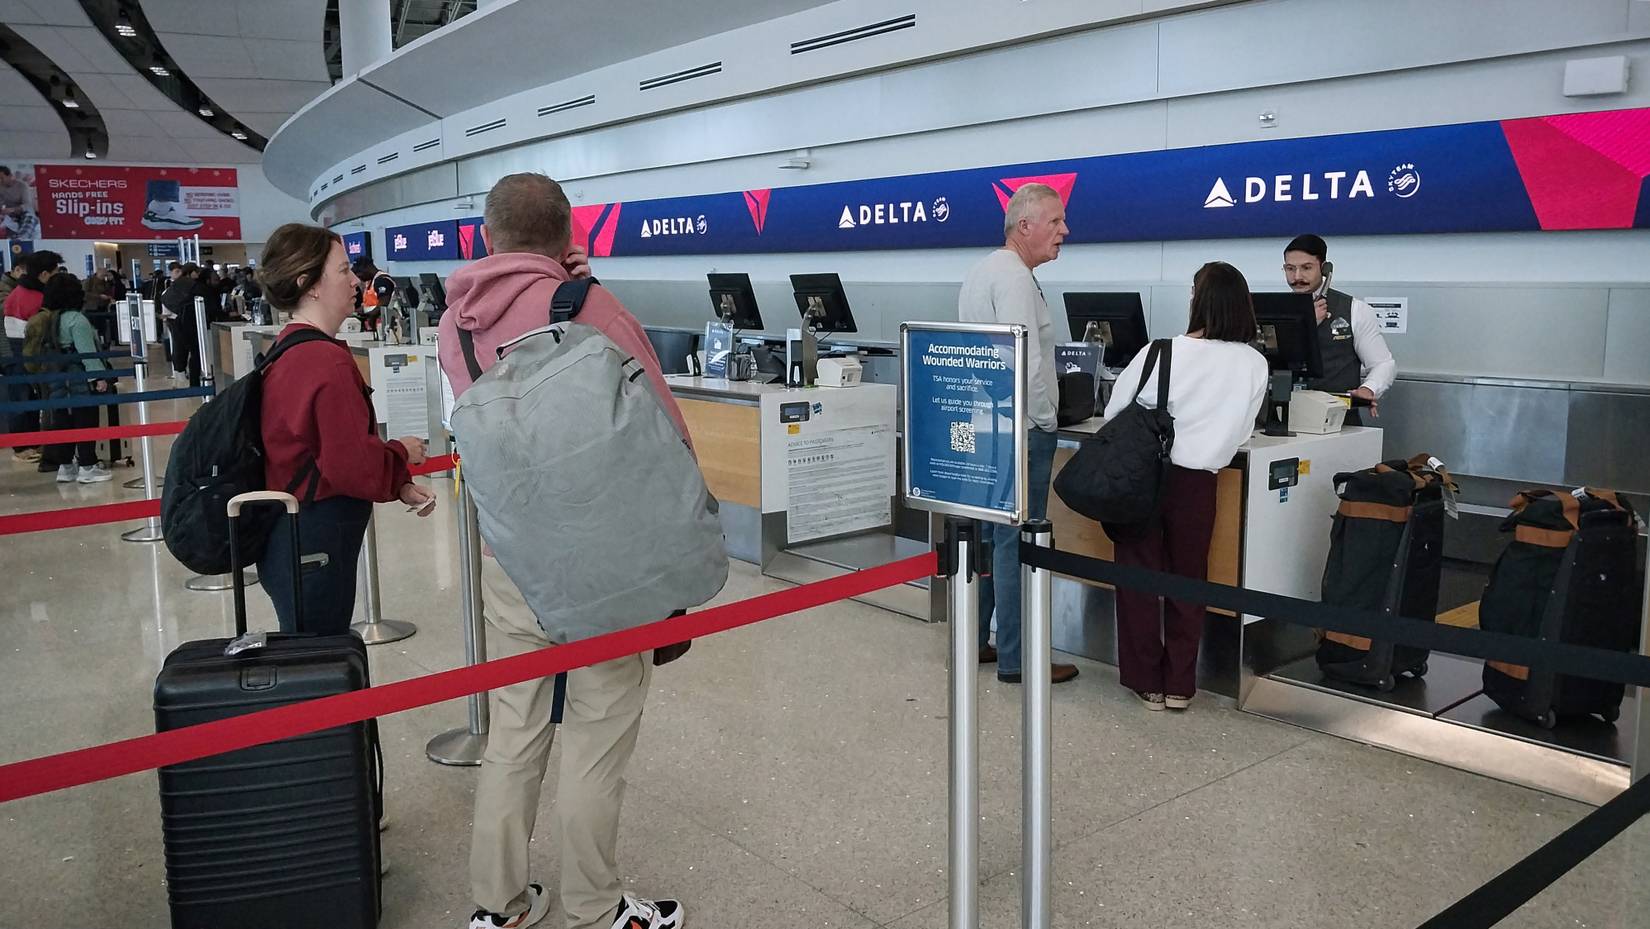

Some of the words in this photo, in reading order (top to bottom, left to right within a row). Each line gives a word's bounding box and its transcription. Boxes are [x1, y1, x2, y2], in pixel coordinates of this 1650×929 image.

[48, 179, 128, 189] SKECHERS
[1245, 170, 1375, 203] DELTA
[51, 191, 83, 199] HANDS
[56, 200, 124, 217] Slip-ins
[859, 201, 927, 225] DELTA
[653, 217, 695, 235] DELTA
[928, 344, 999, 359] Accommodating
[922, 355, 964, 368] Wounded
[966, 357, 1006, 371] Warriors
[943, 376, 961, 384] honors
[961, 378, 974, 386] your
[974, 378, 993, 387] service
[941, 405, 958, 413] airport
